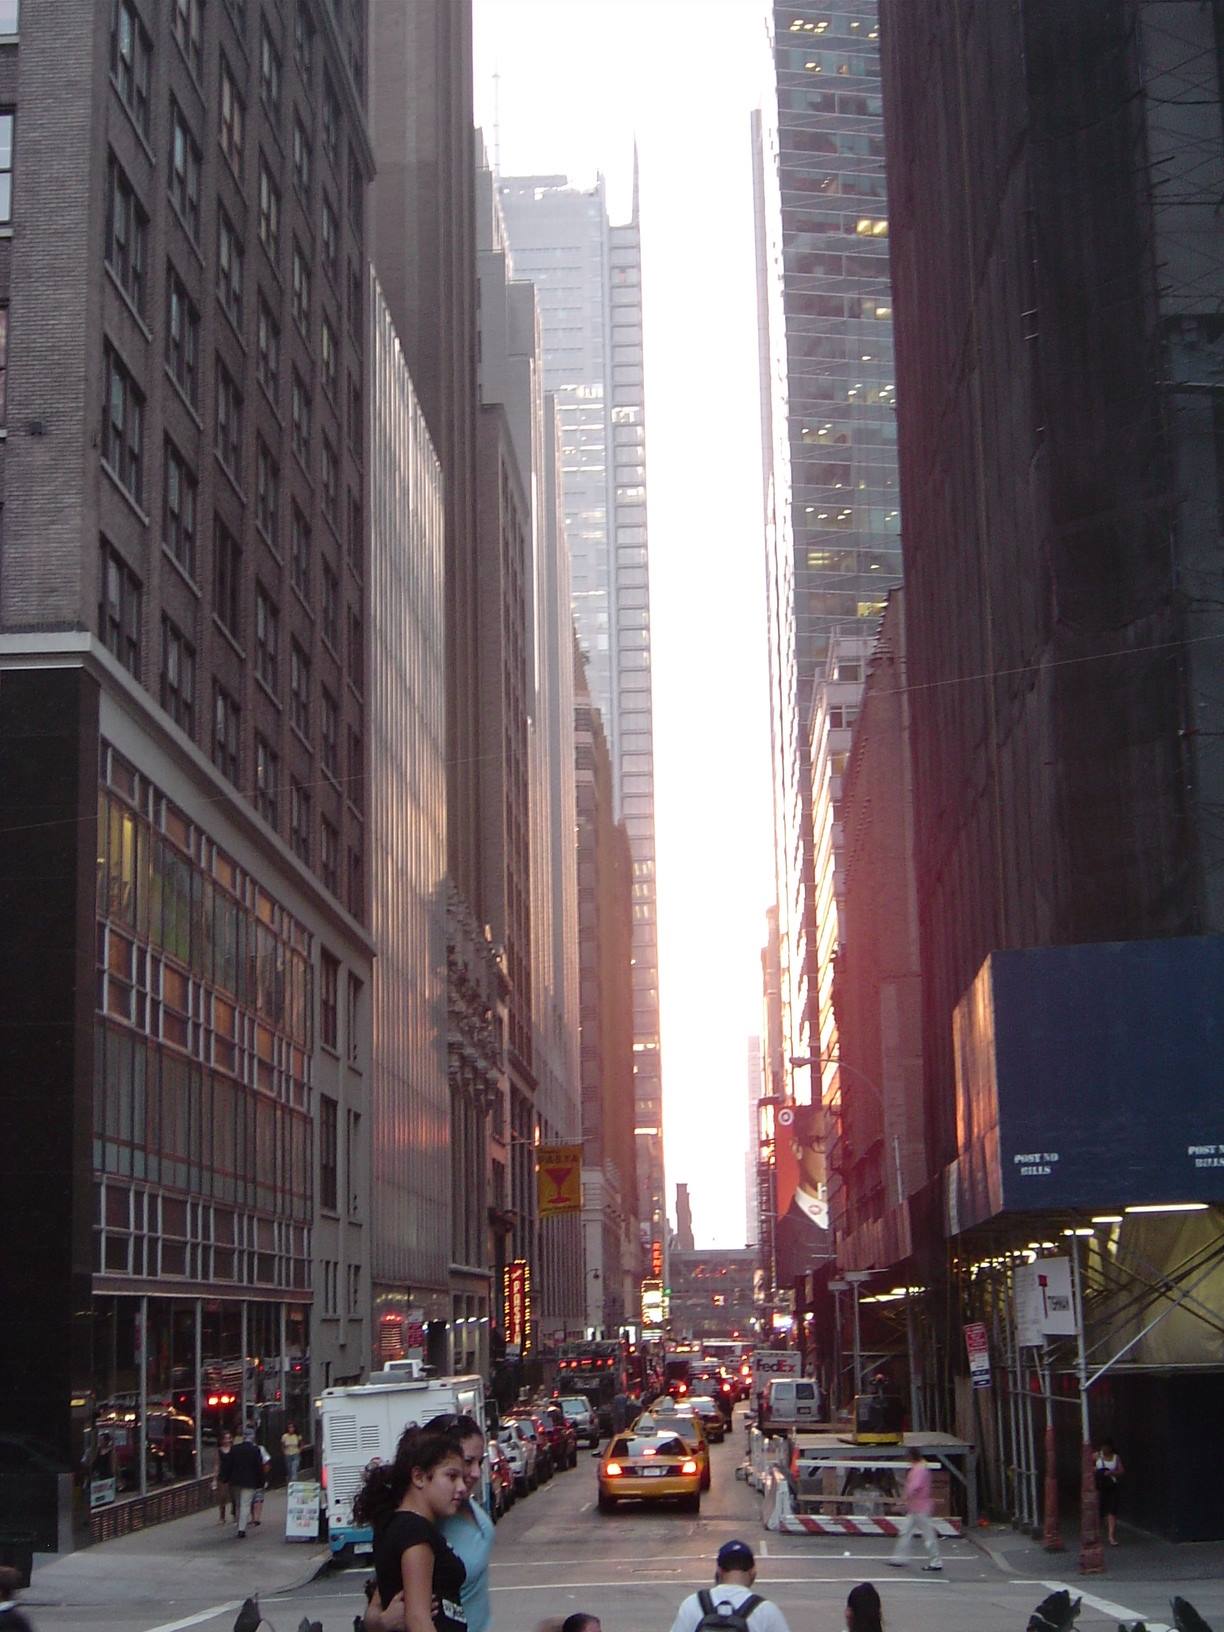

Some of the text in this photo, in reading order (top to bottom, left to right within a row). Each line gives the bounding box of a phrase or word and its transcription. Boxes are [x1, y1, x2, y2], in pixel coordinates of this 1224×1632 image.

[1188, 1145, 1216, 1155] POST
[1014, 1152, 1059, 1164] POST NO
[1195, 1157, 1224, 1168] BILLS
[1020, 1165, 1051, 1175] BILLS
[756, 1358, 796, 1373] FedEx
